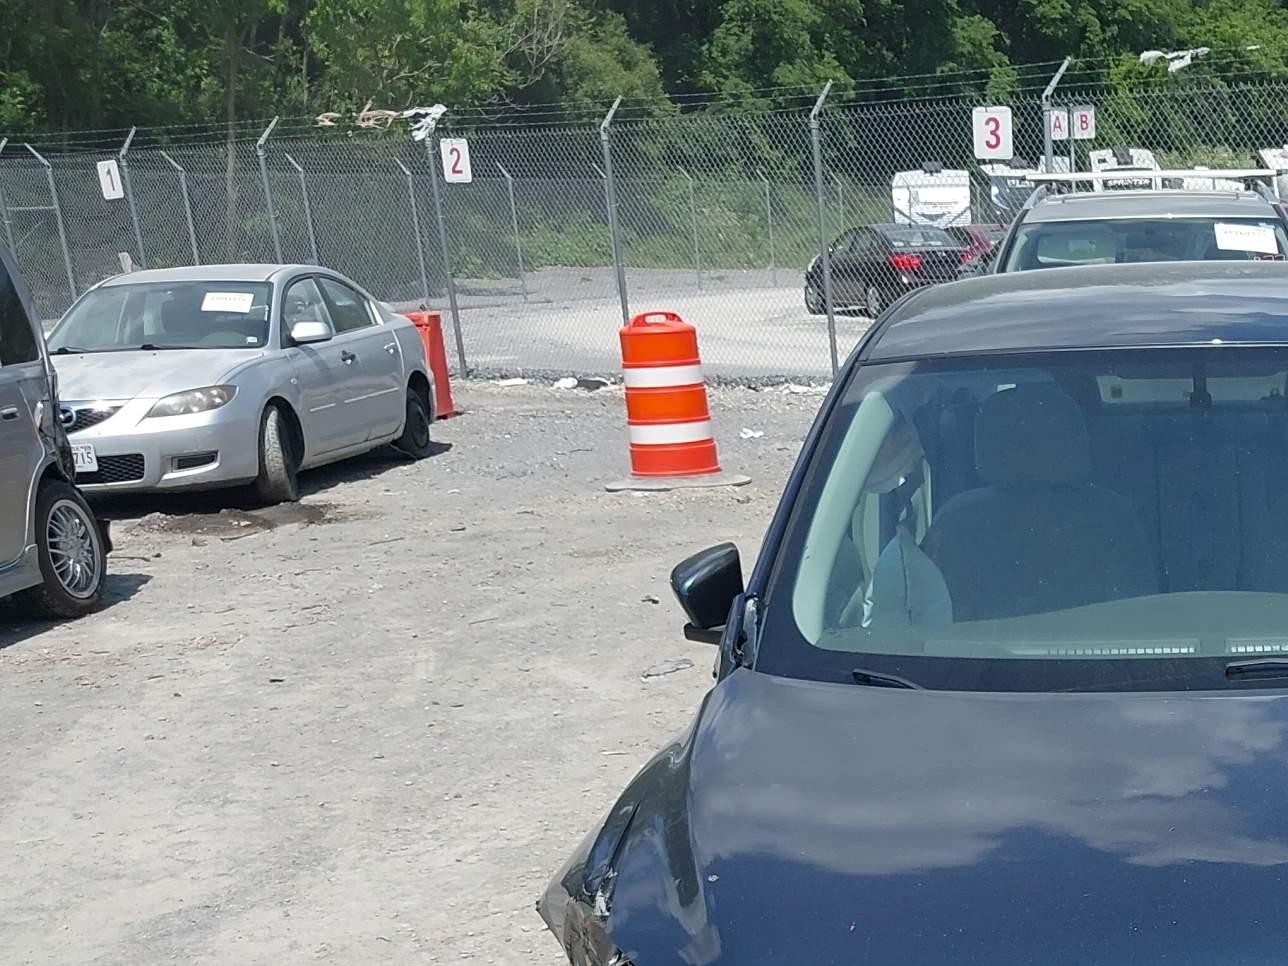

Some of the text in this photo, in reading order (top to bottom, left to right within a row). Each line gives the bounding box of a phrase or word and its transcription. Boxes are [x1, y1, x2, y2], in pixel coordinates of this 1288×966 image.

[1052, 115, 1062, 132] A
[1079, 114, 1089, 130] B
[984, 117, 1001, 149] 3
[449, 147, 463, 174] 2
[105, 167, 115, 192] 1
[1107, 178, 1150, 187] SPRINTER
